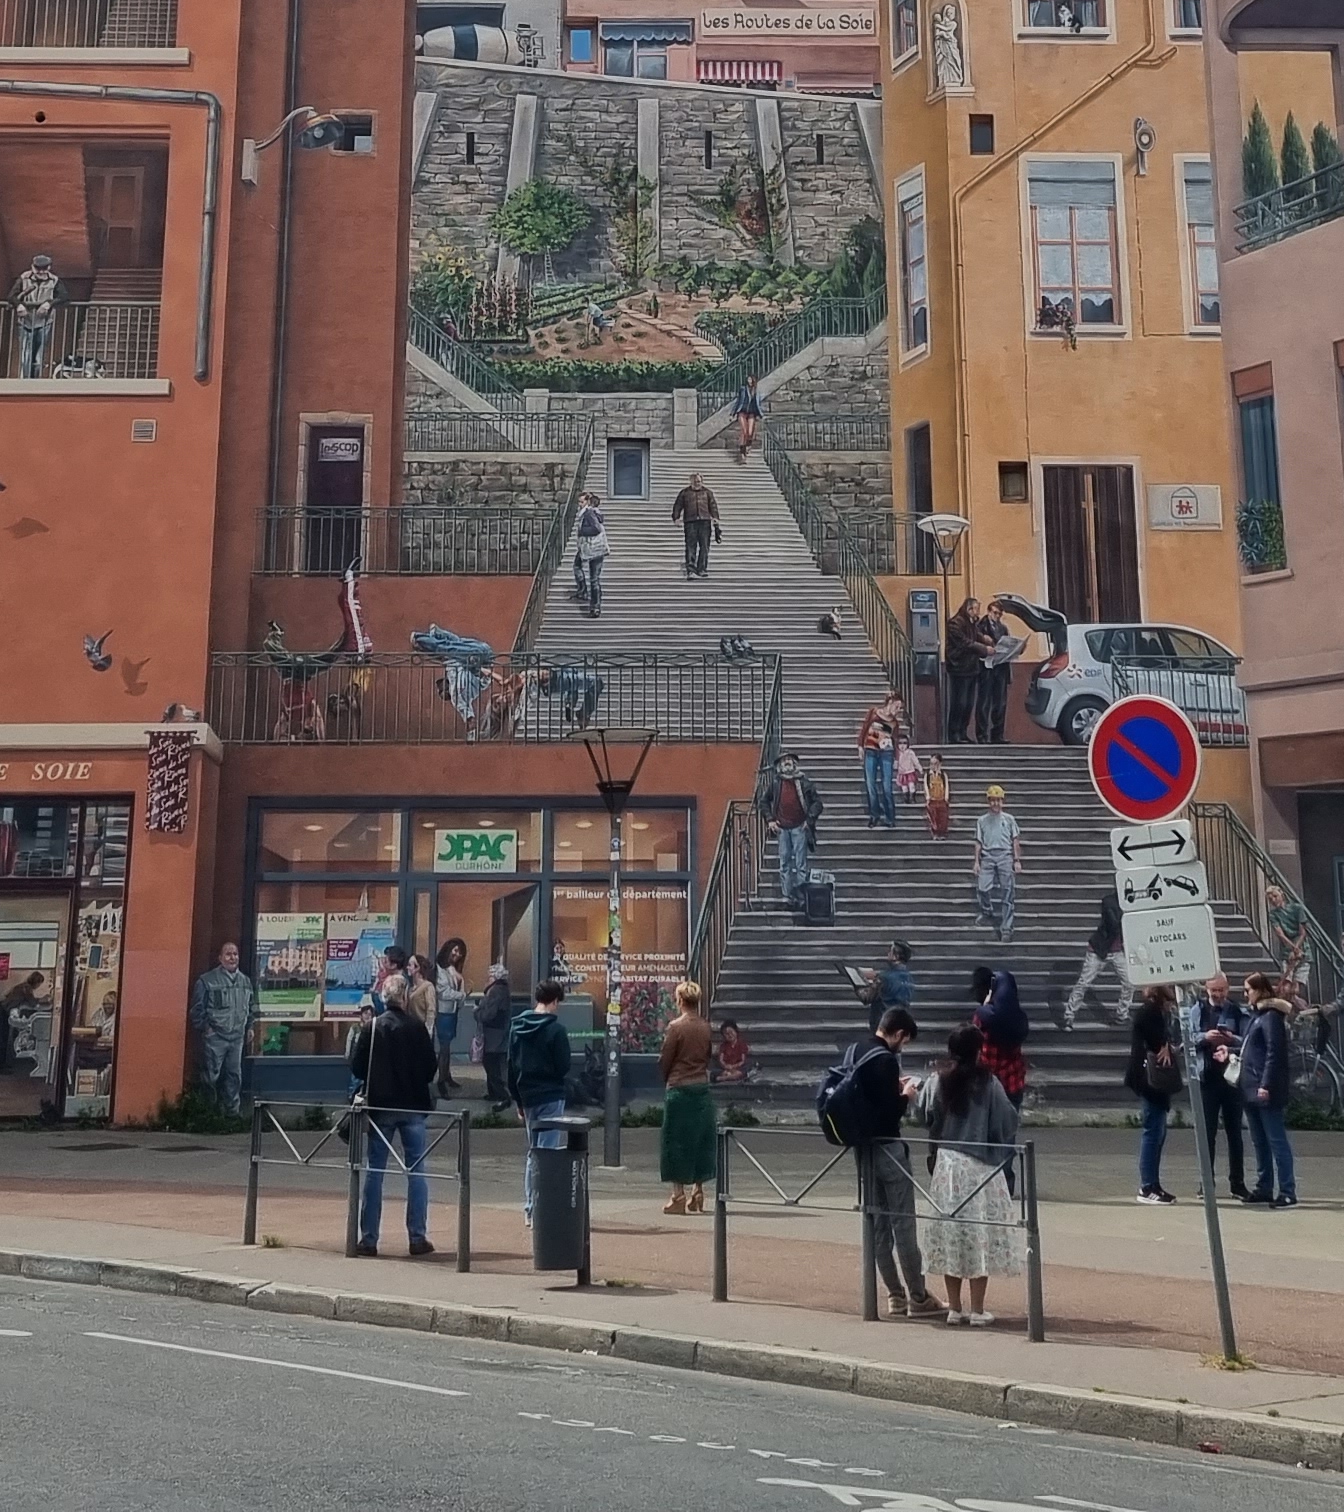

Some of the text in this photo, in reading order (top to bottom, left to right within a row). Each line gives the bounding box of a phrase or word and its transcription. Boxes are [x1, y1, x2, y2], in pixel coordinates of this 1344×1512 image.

[702, 13, 873, 30] Les Routes de La Soie
[31, 762, 93, 781] SOIE
[437, 833, 515, 862] OPAC
[622, 888, 689, 900] département
[1156, 918, 1174, 927] SAUF
[1149, 933, 1187, 943] AUTOCARS
[1164, 949, 1174, 958] DE
[619, 975, 648, 983] ABITAT
